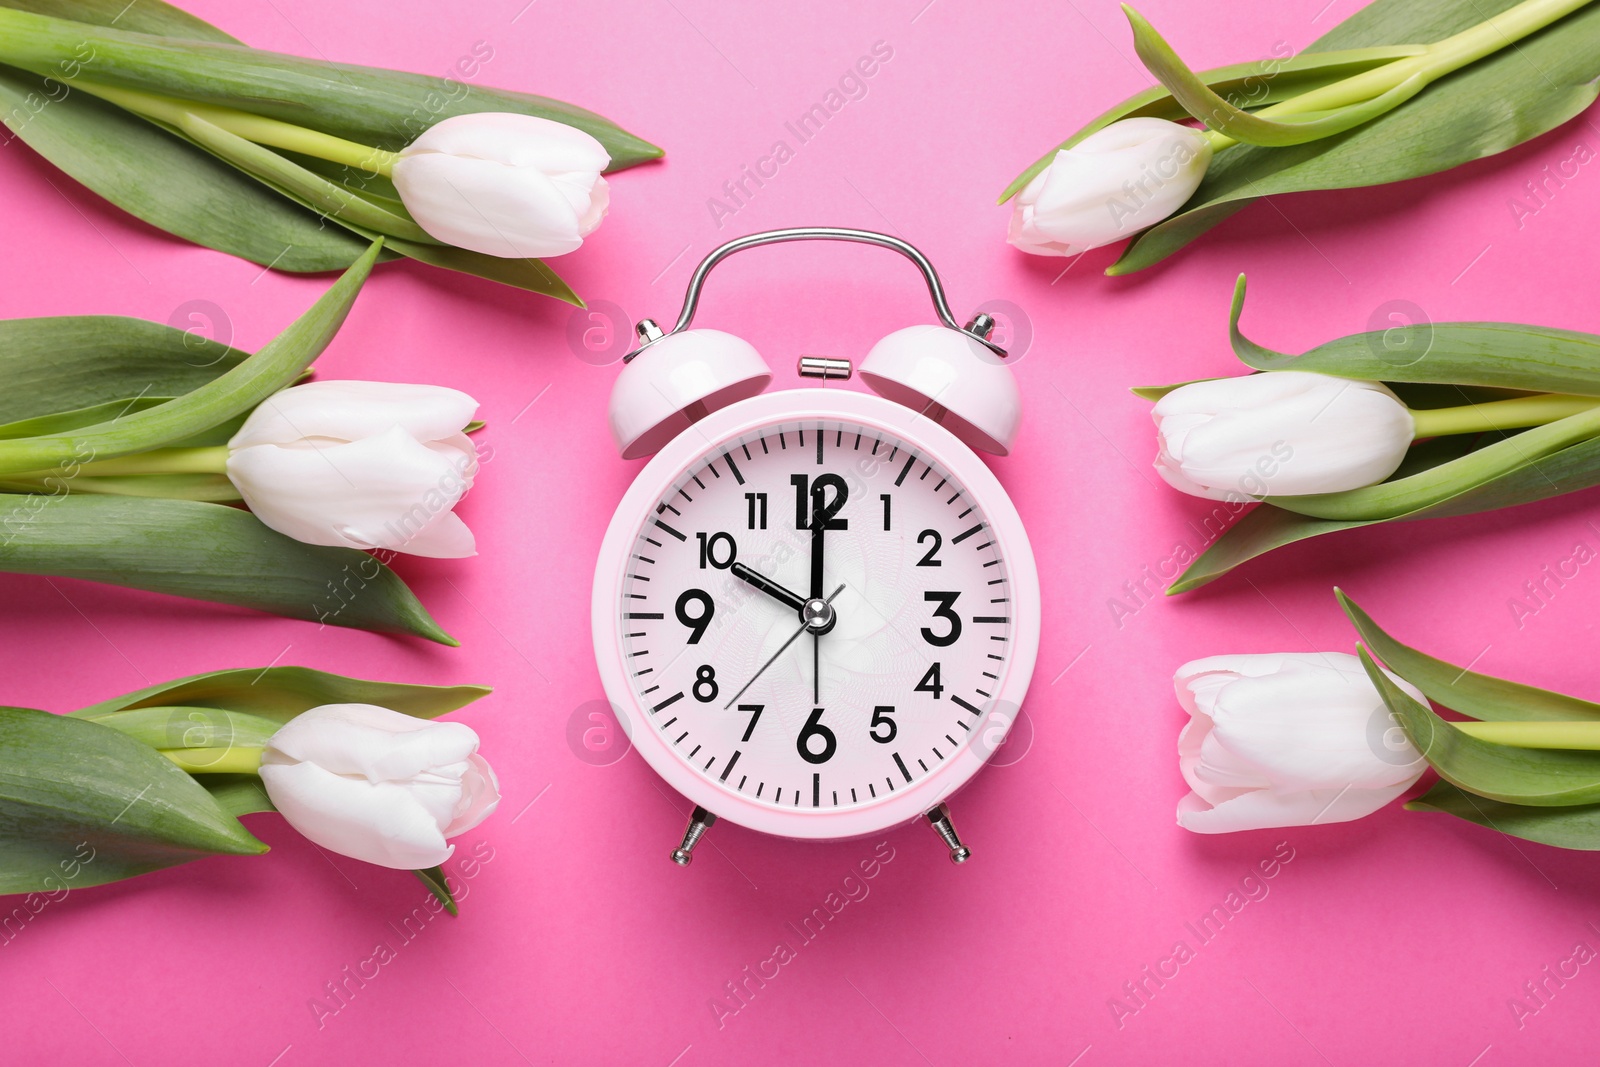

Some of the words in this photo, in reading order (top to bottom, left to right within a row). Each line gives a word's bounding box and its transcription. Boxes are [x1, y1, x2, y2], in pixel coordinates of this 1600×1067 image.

[745, 493, 767, 529] 11
[791, 474, 848, 531] 12
[880, 494, 890, 531] 1
[697, 532, 737, 569] 10
[916, 529, 942, 566] 2
[675, 589, 714, 644] 9
[921, 591, 962, 647] 3
[693, 665, 718, 702] 8
[914, 663, 943, 699] 4
[738, 705, 764, 741] 7
[797, 709, 837, 764] 6
[870, 706, 897, 743] 5
